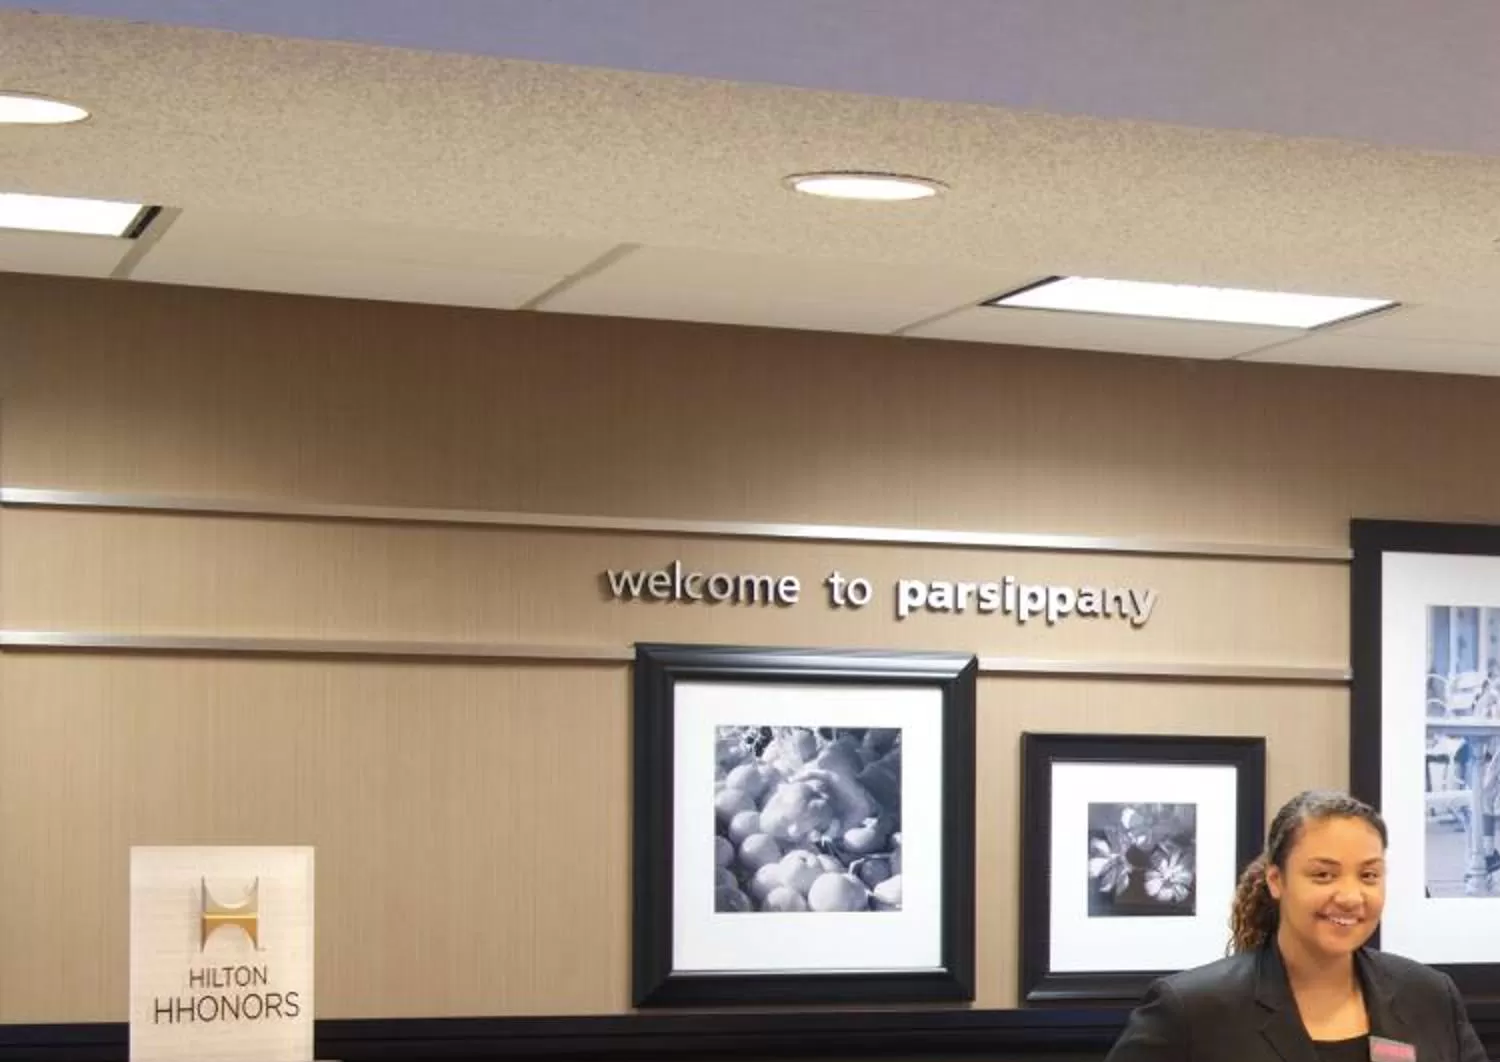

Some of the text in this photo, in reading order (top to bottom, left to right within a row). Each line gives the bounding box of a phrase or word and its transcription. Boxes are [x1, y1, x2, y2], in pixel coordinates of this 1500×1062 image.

[605, 559, 1160, 627] welcome to parsippany
[189, 965, 269, 989] HILTON
[153, 991, 301, 1025] HHONORS
